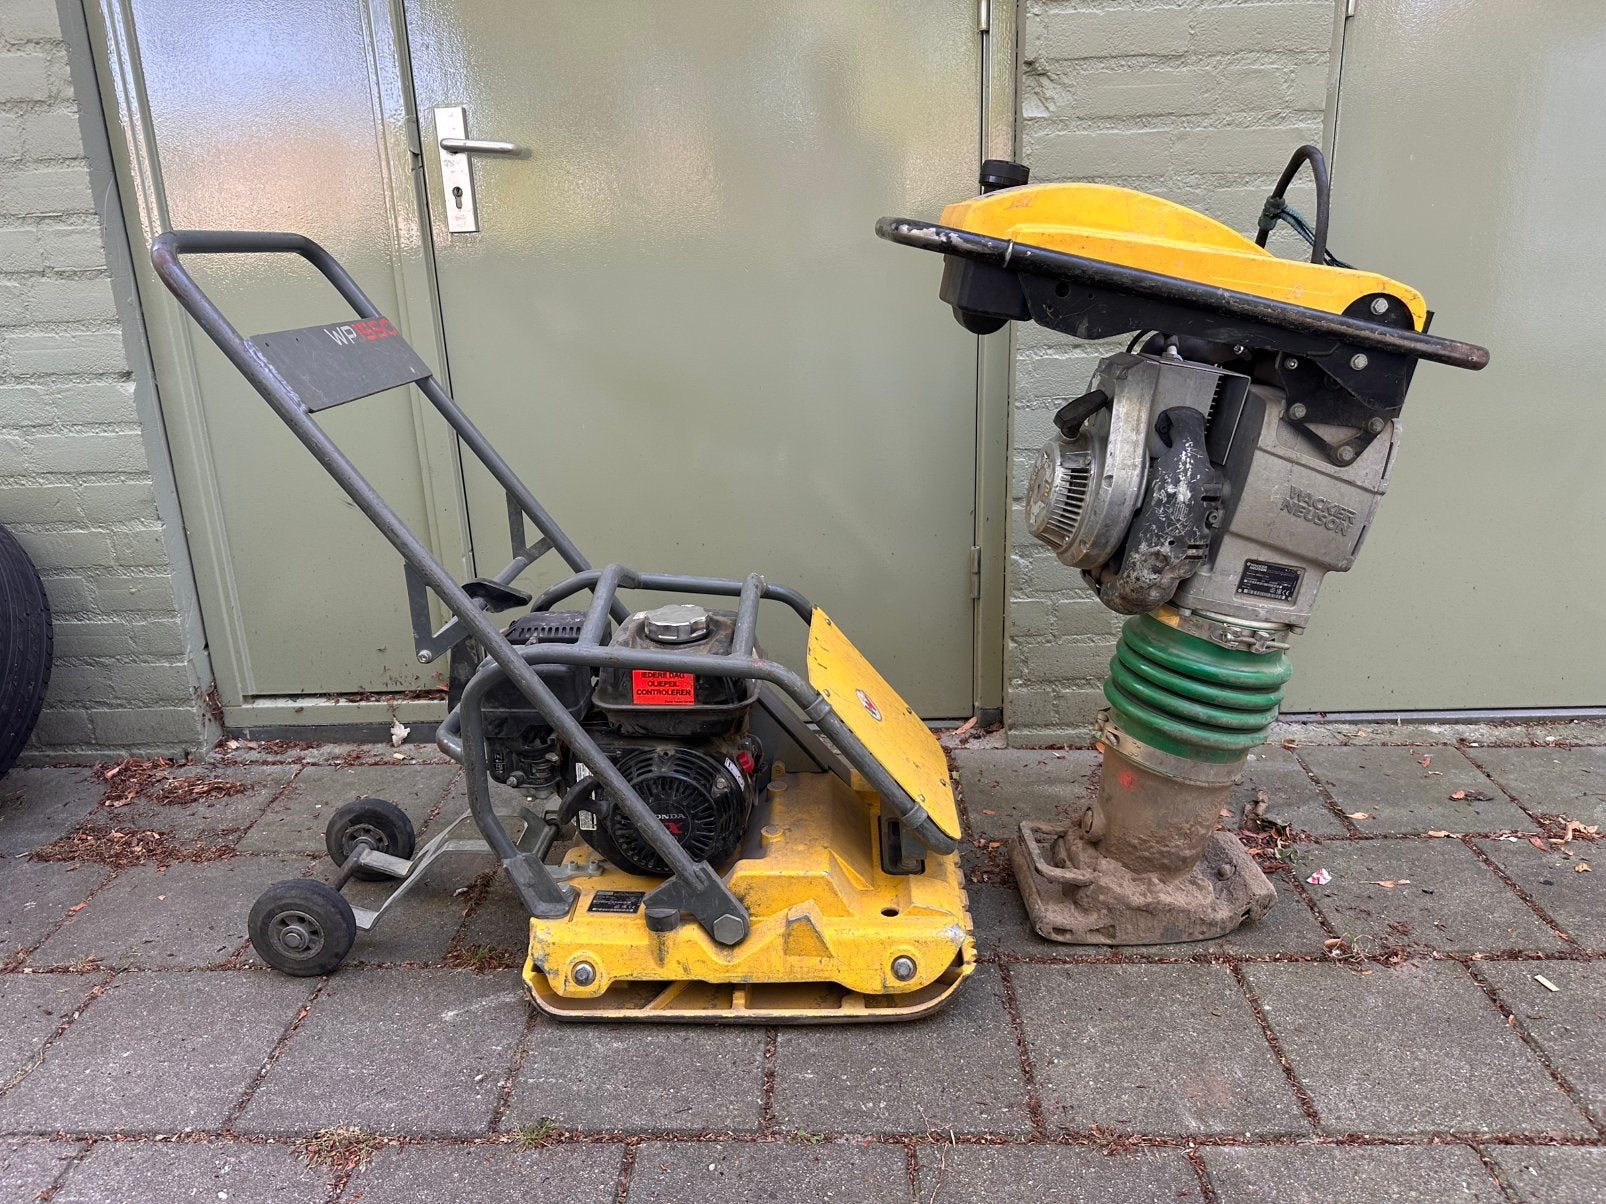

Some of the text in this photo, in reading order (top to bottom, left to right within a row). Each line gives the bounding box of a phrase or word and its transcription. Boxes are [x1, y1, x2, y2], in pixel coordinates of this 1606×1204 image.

[1280, 497, 1349, 537] NEUSON
[1289, 484, 1357, 526] WACKER
[636, 688, 691, 696] CONTROLEREN
